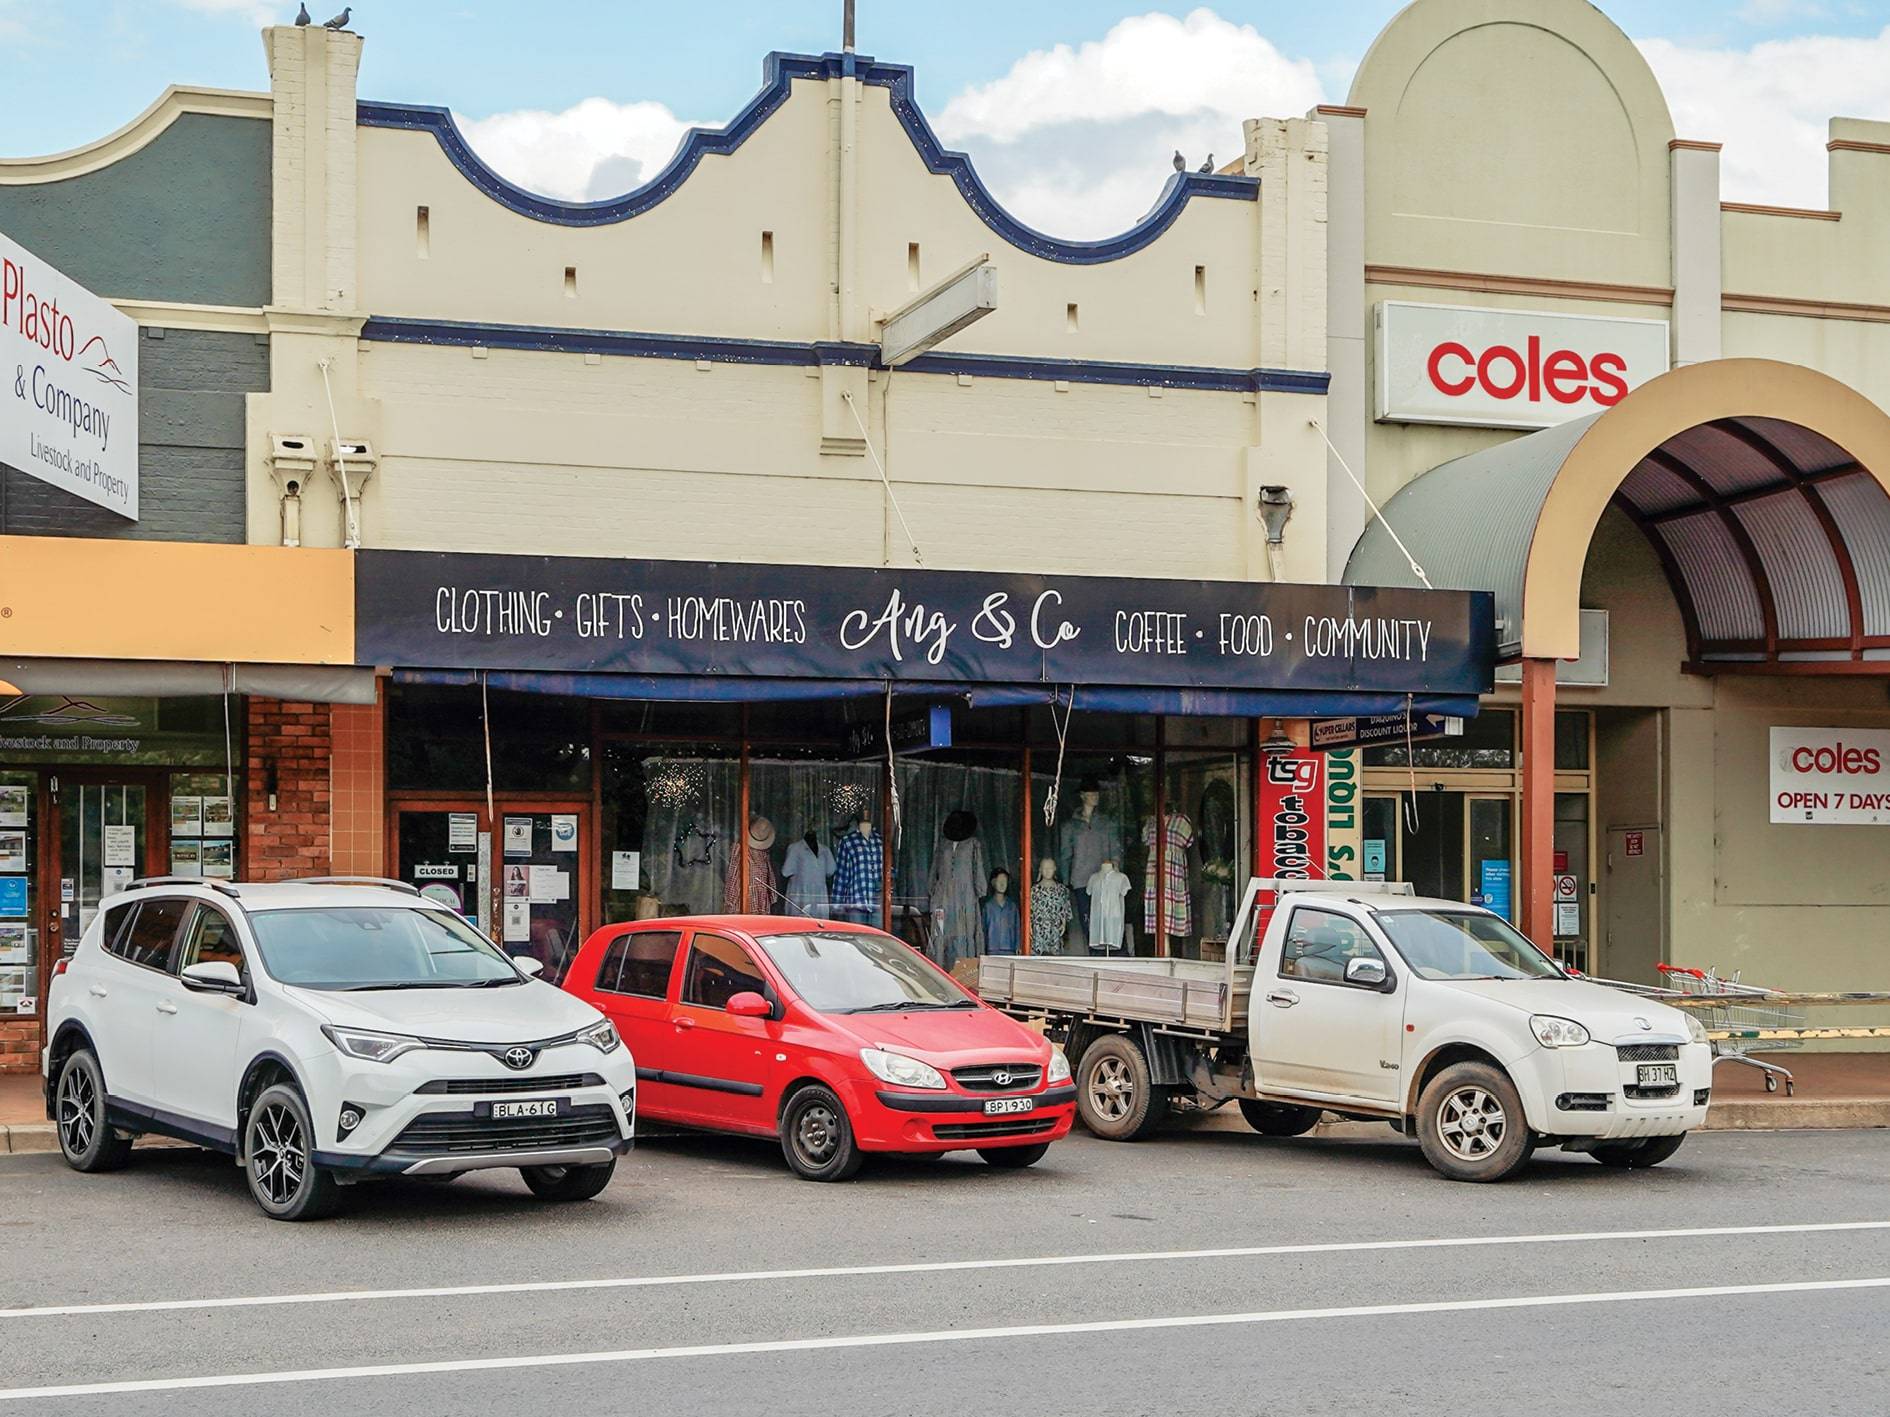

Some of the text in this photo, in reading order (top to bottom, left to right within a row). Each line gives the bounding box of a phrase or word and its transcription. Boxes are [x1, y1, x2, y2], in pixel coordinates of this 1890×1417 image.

[2, 257, 75, 362] Plasto
[1427, 335, 1629, 406] coles
[14, 364, 111, 452] & Company
[30, 431, 130, 505] Livestock and Property
[435, 587, 1432, 664] CLOTHING GIFTS HOMEWARES Ang & Co COFFEE FOOD COMMUNITY
[53, 735, 80, 750] and
[81, 735, 140, 753] Property
[1360, 725, 1391, 739] DISCOUNT
[1791, 742, 1881, 774] coles
[1266, 755, 1319, 793] tsg
[1777, 792, 1828, 809] OPEN
[1833, 793, 1845, 809] 7
